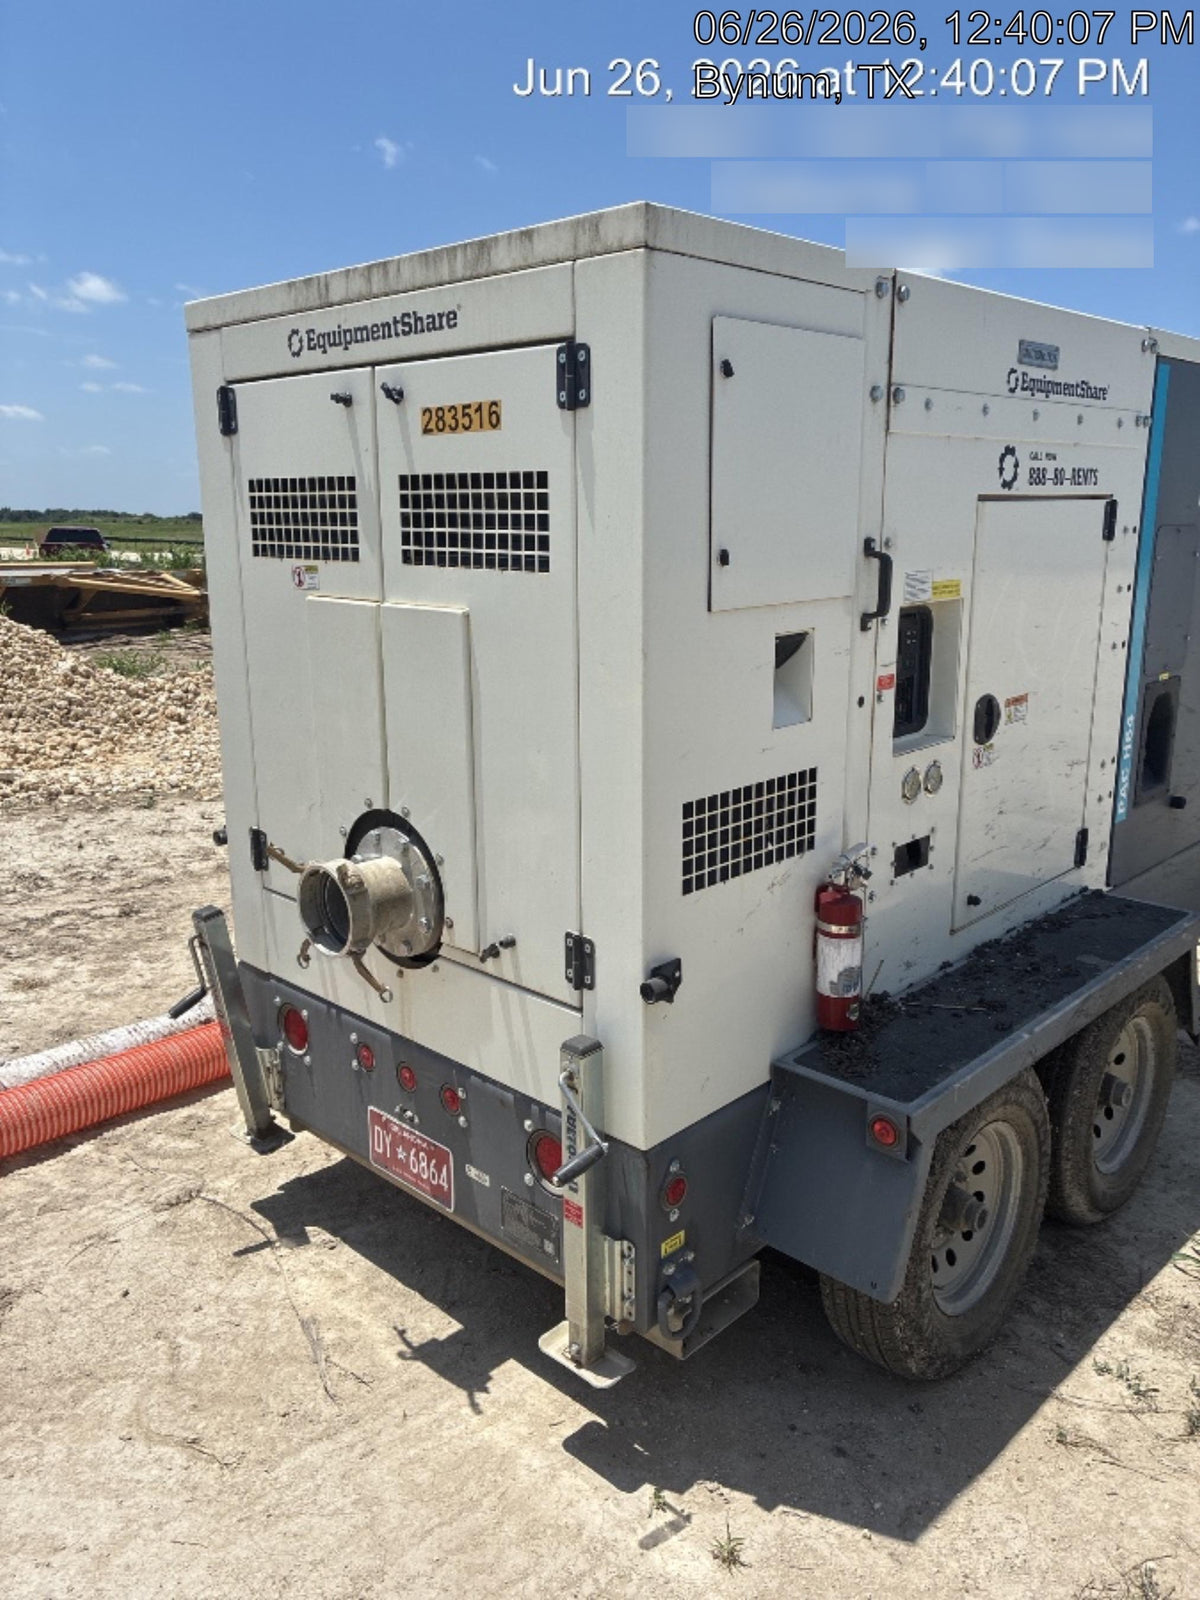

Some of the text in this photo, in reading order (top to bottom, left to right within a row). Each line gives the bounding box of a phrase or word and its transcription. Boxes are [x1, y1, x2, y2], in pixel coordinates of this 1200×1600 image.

[305, 308, 458, 354] EquipmentShare
[1020, 371, 1110, 401] EquipmentShare
[421, 401, 501, 434] 283516
[409, 1147, 449, 1192] 6864
